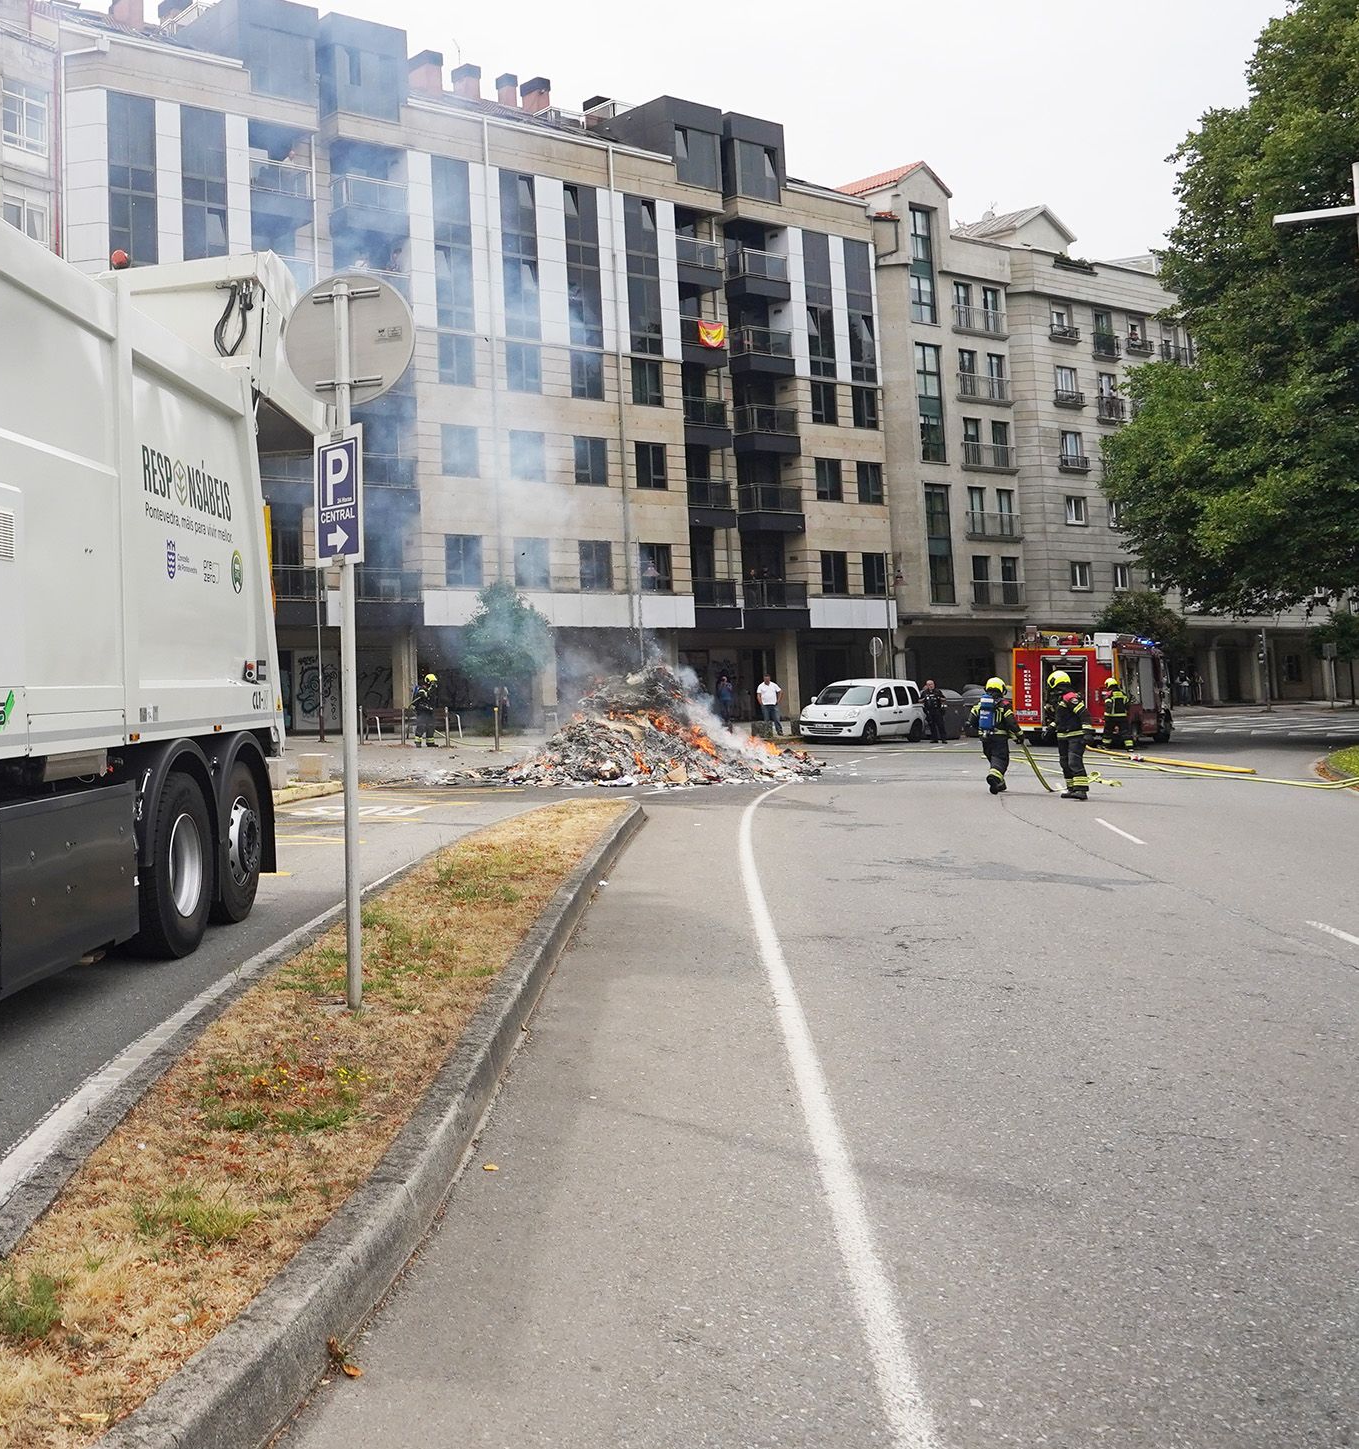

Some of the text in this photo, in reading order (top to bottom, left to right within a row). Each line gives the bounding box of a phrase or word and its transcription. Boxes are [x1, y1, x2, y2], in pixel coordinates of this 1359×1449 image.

[327, 448, 349, 506] P
[145, 501, 181, 528] Pontevedra,
[194, 521, 206, 535] para
[207, 523, 217, 538] vivir
[320, 507, 356, 524] CENTRAL
[204, 573, 217, 584] zero
